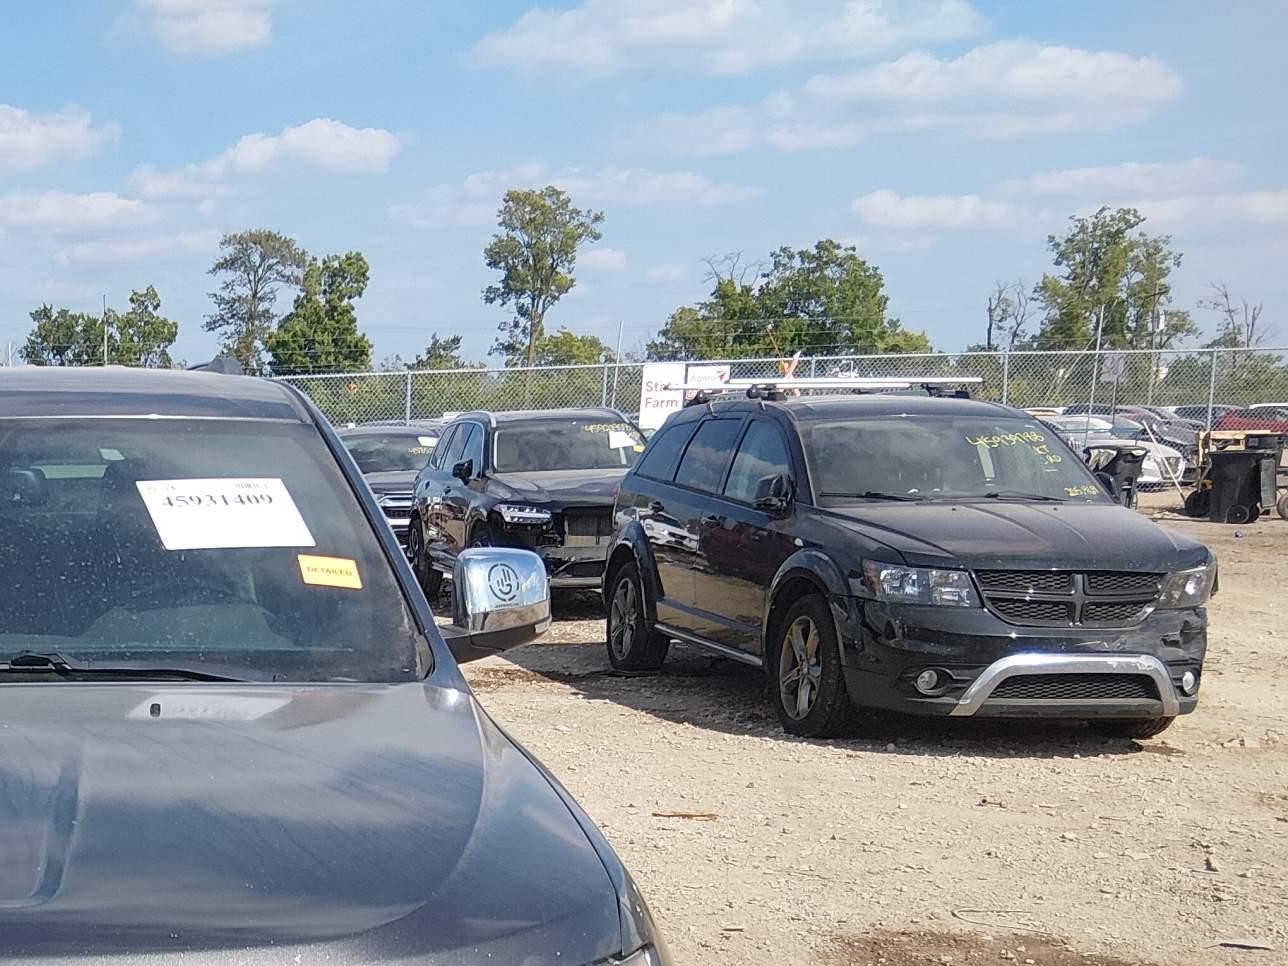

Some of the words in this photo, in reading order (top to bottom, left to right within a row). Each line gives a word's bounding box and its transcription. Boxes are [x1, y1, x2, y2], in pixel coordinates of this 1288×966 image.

[644, 397, 678, 409] Farm
[162, 493, 273, 507] 45931409
[306, 566, 352, 577] DETAILED
